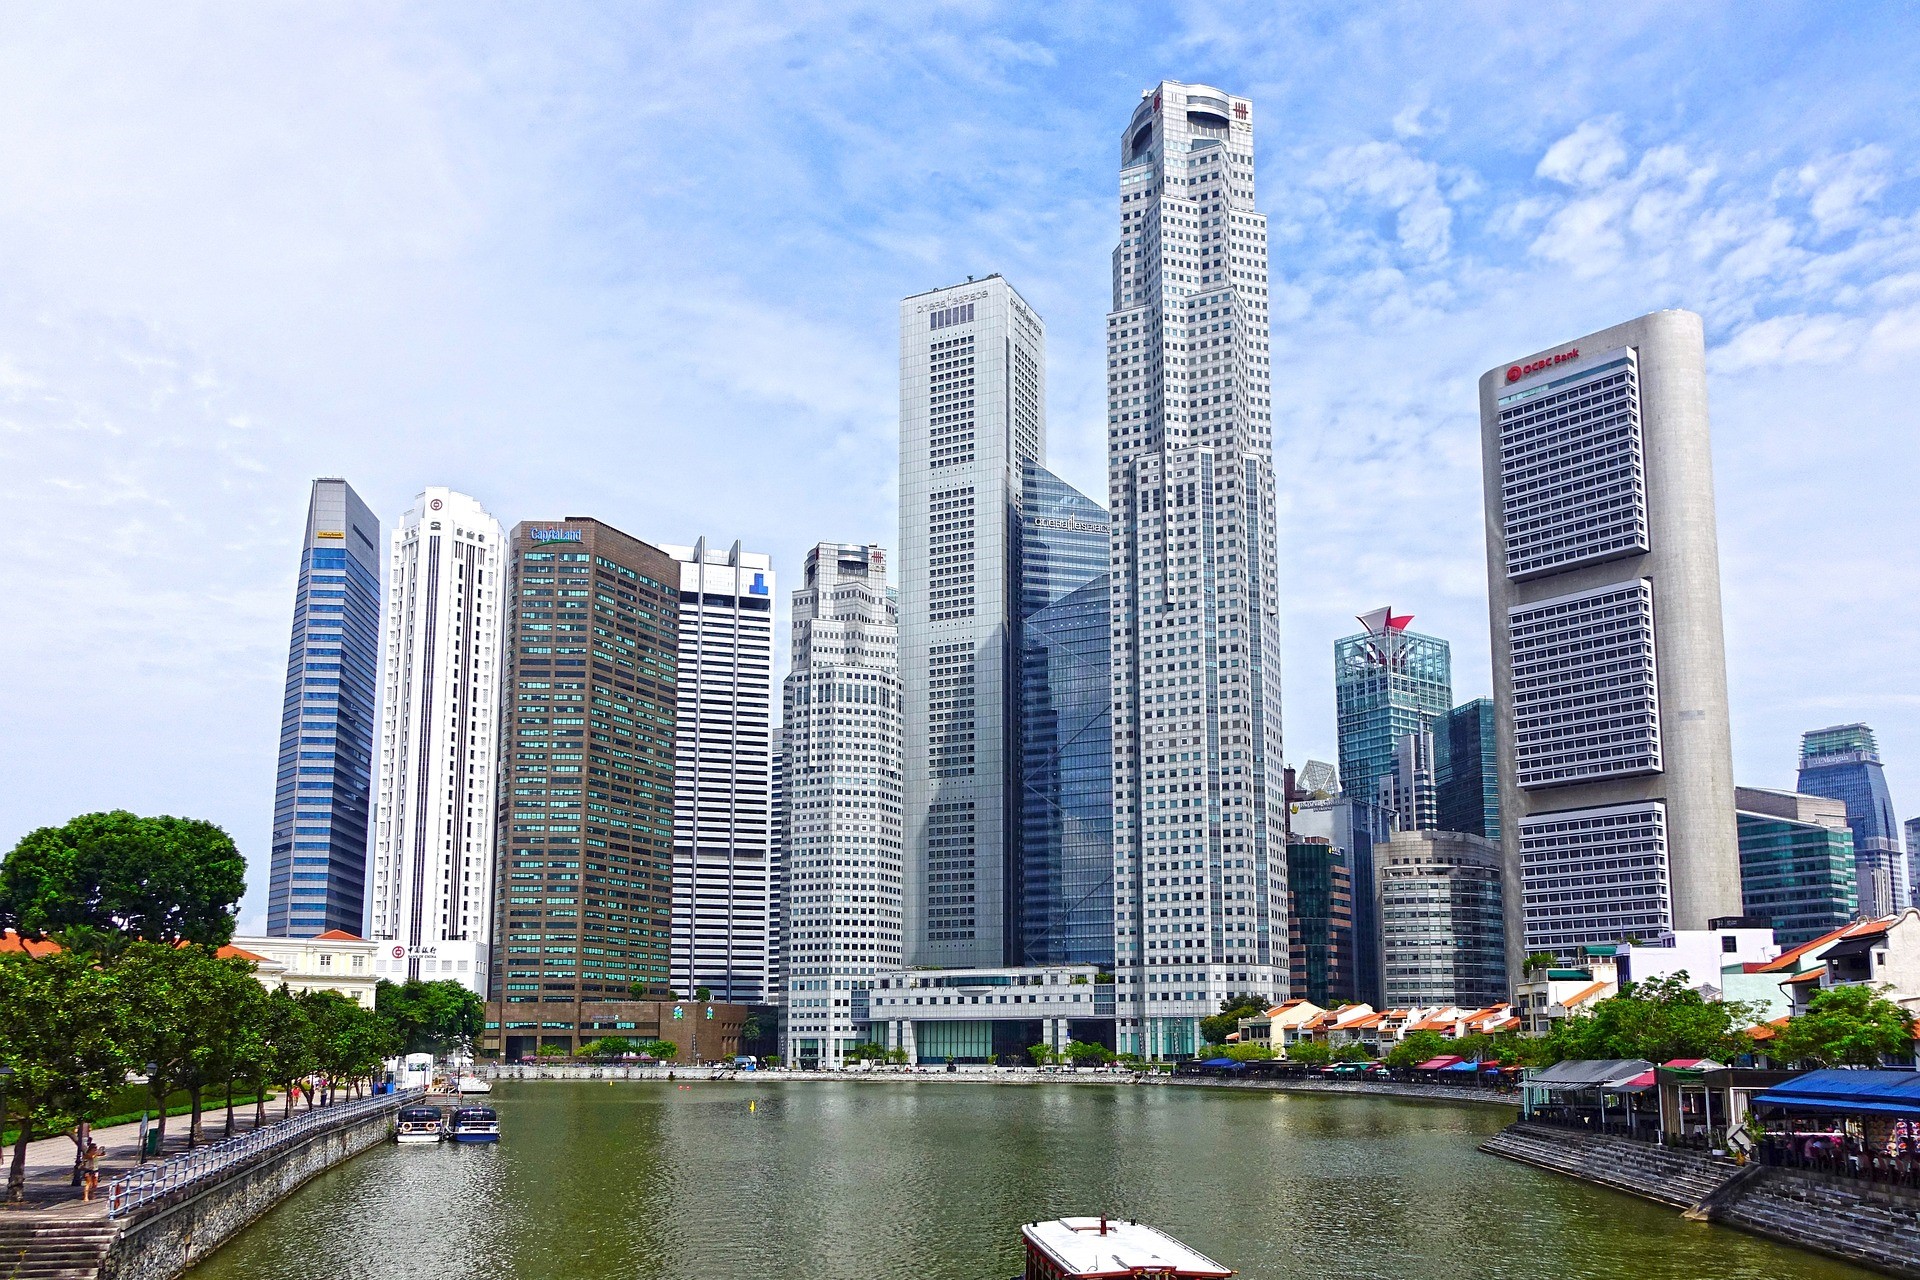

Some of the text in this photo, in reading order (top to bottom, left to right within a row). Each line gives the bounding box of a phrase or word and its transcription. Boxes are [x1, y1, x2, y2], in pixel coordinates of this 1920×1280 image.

[1523, 348, 1579, 374] OCBC Bank
[530, 525, 581, 542] CapitaLand
